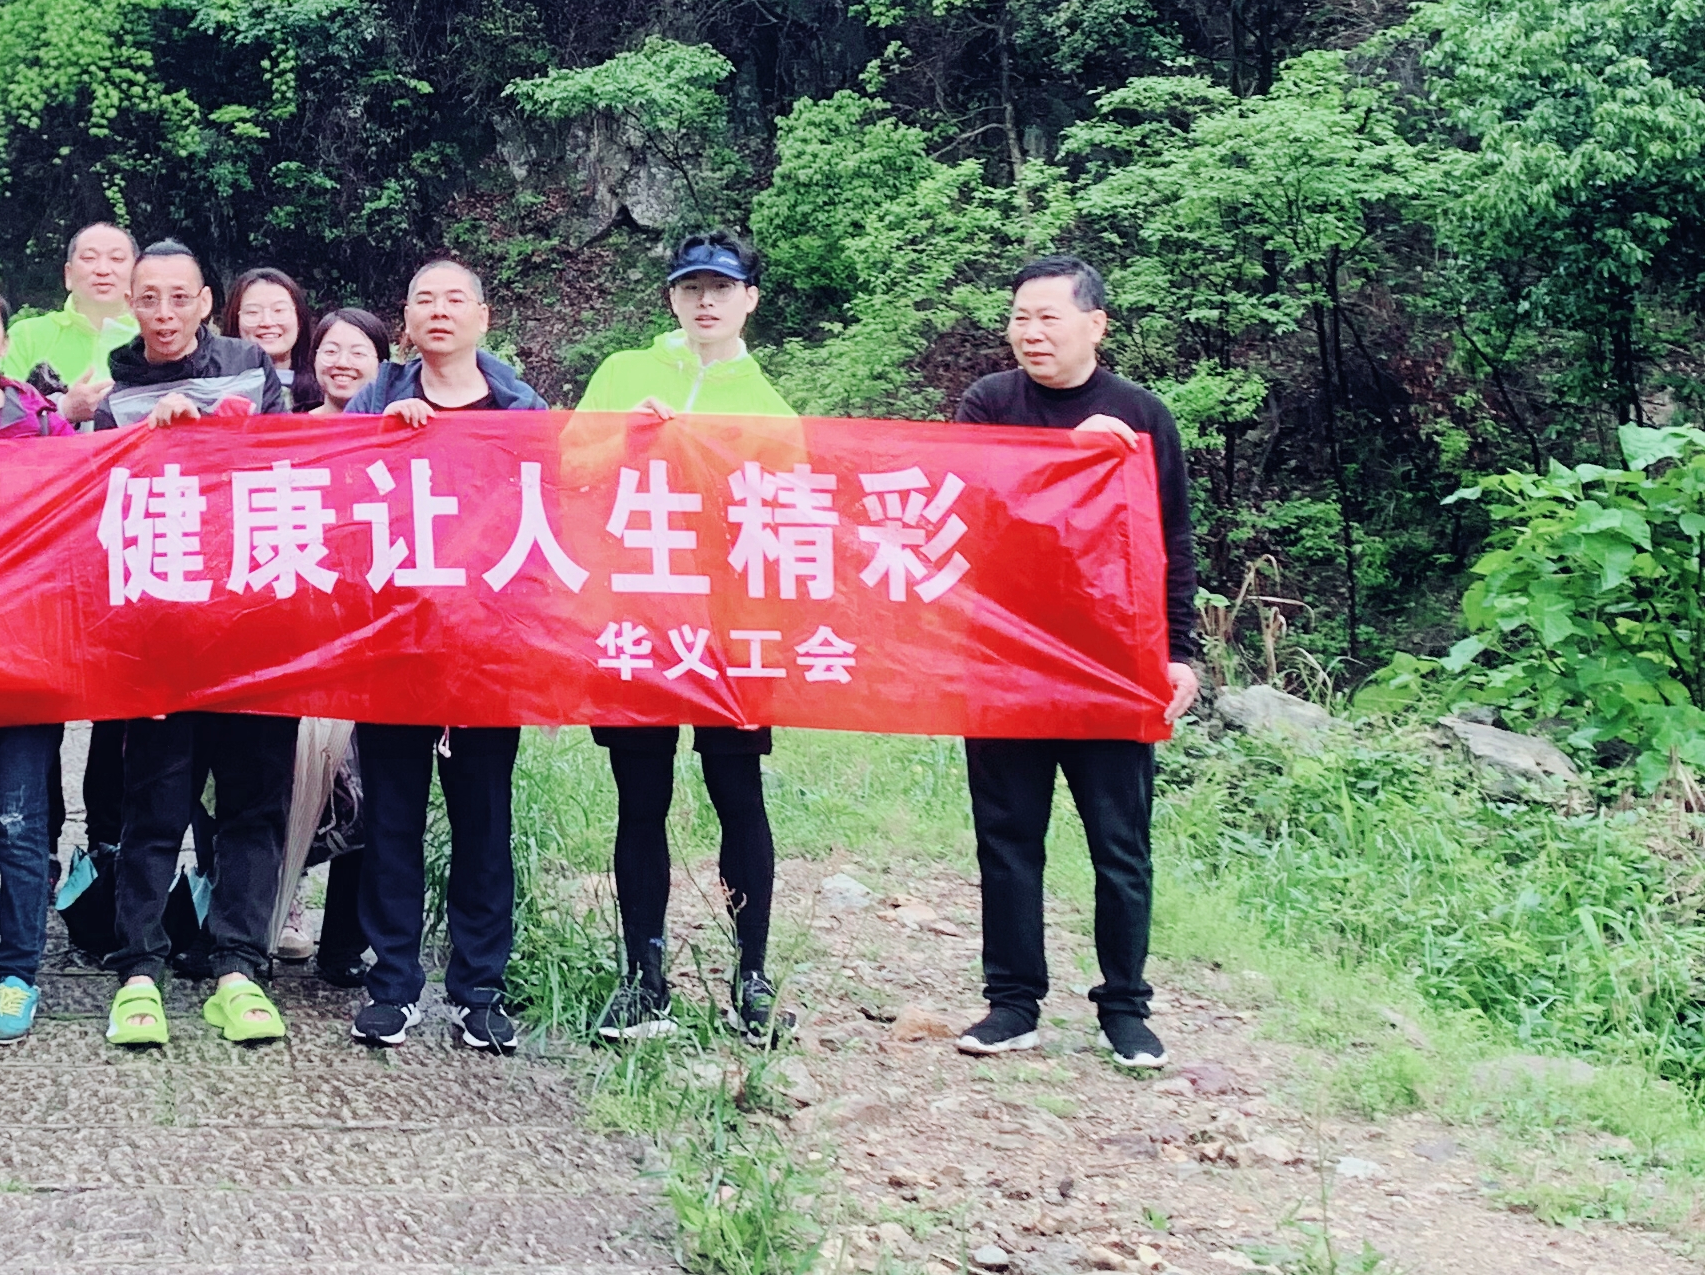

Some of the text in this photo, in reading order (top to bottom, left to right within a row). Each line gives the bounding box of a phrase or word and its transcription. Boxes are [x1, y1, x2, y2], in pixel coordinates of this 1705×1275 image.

[96, 458, 971, 606] 健康让人生精彩
[595, 620, 858, 685] 华义工会
